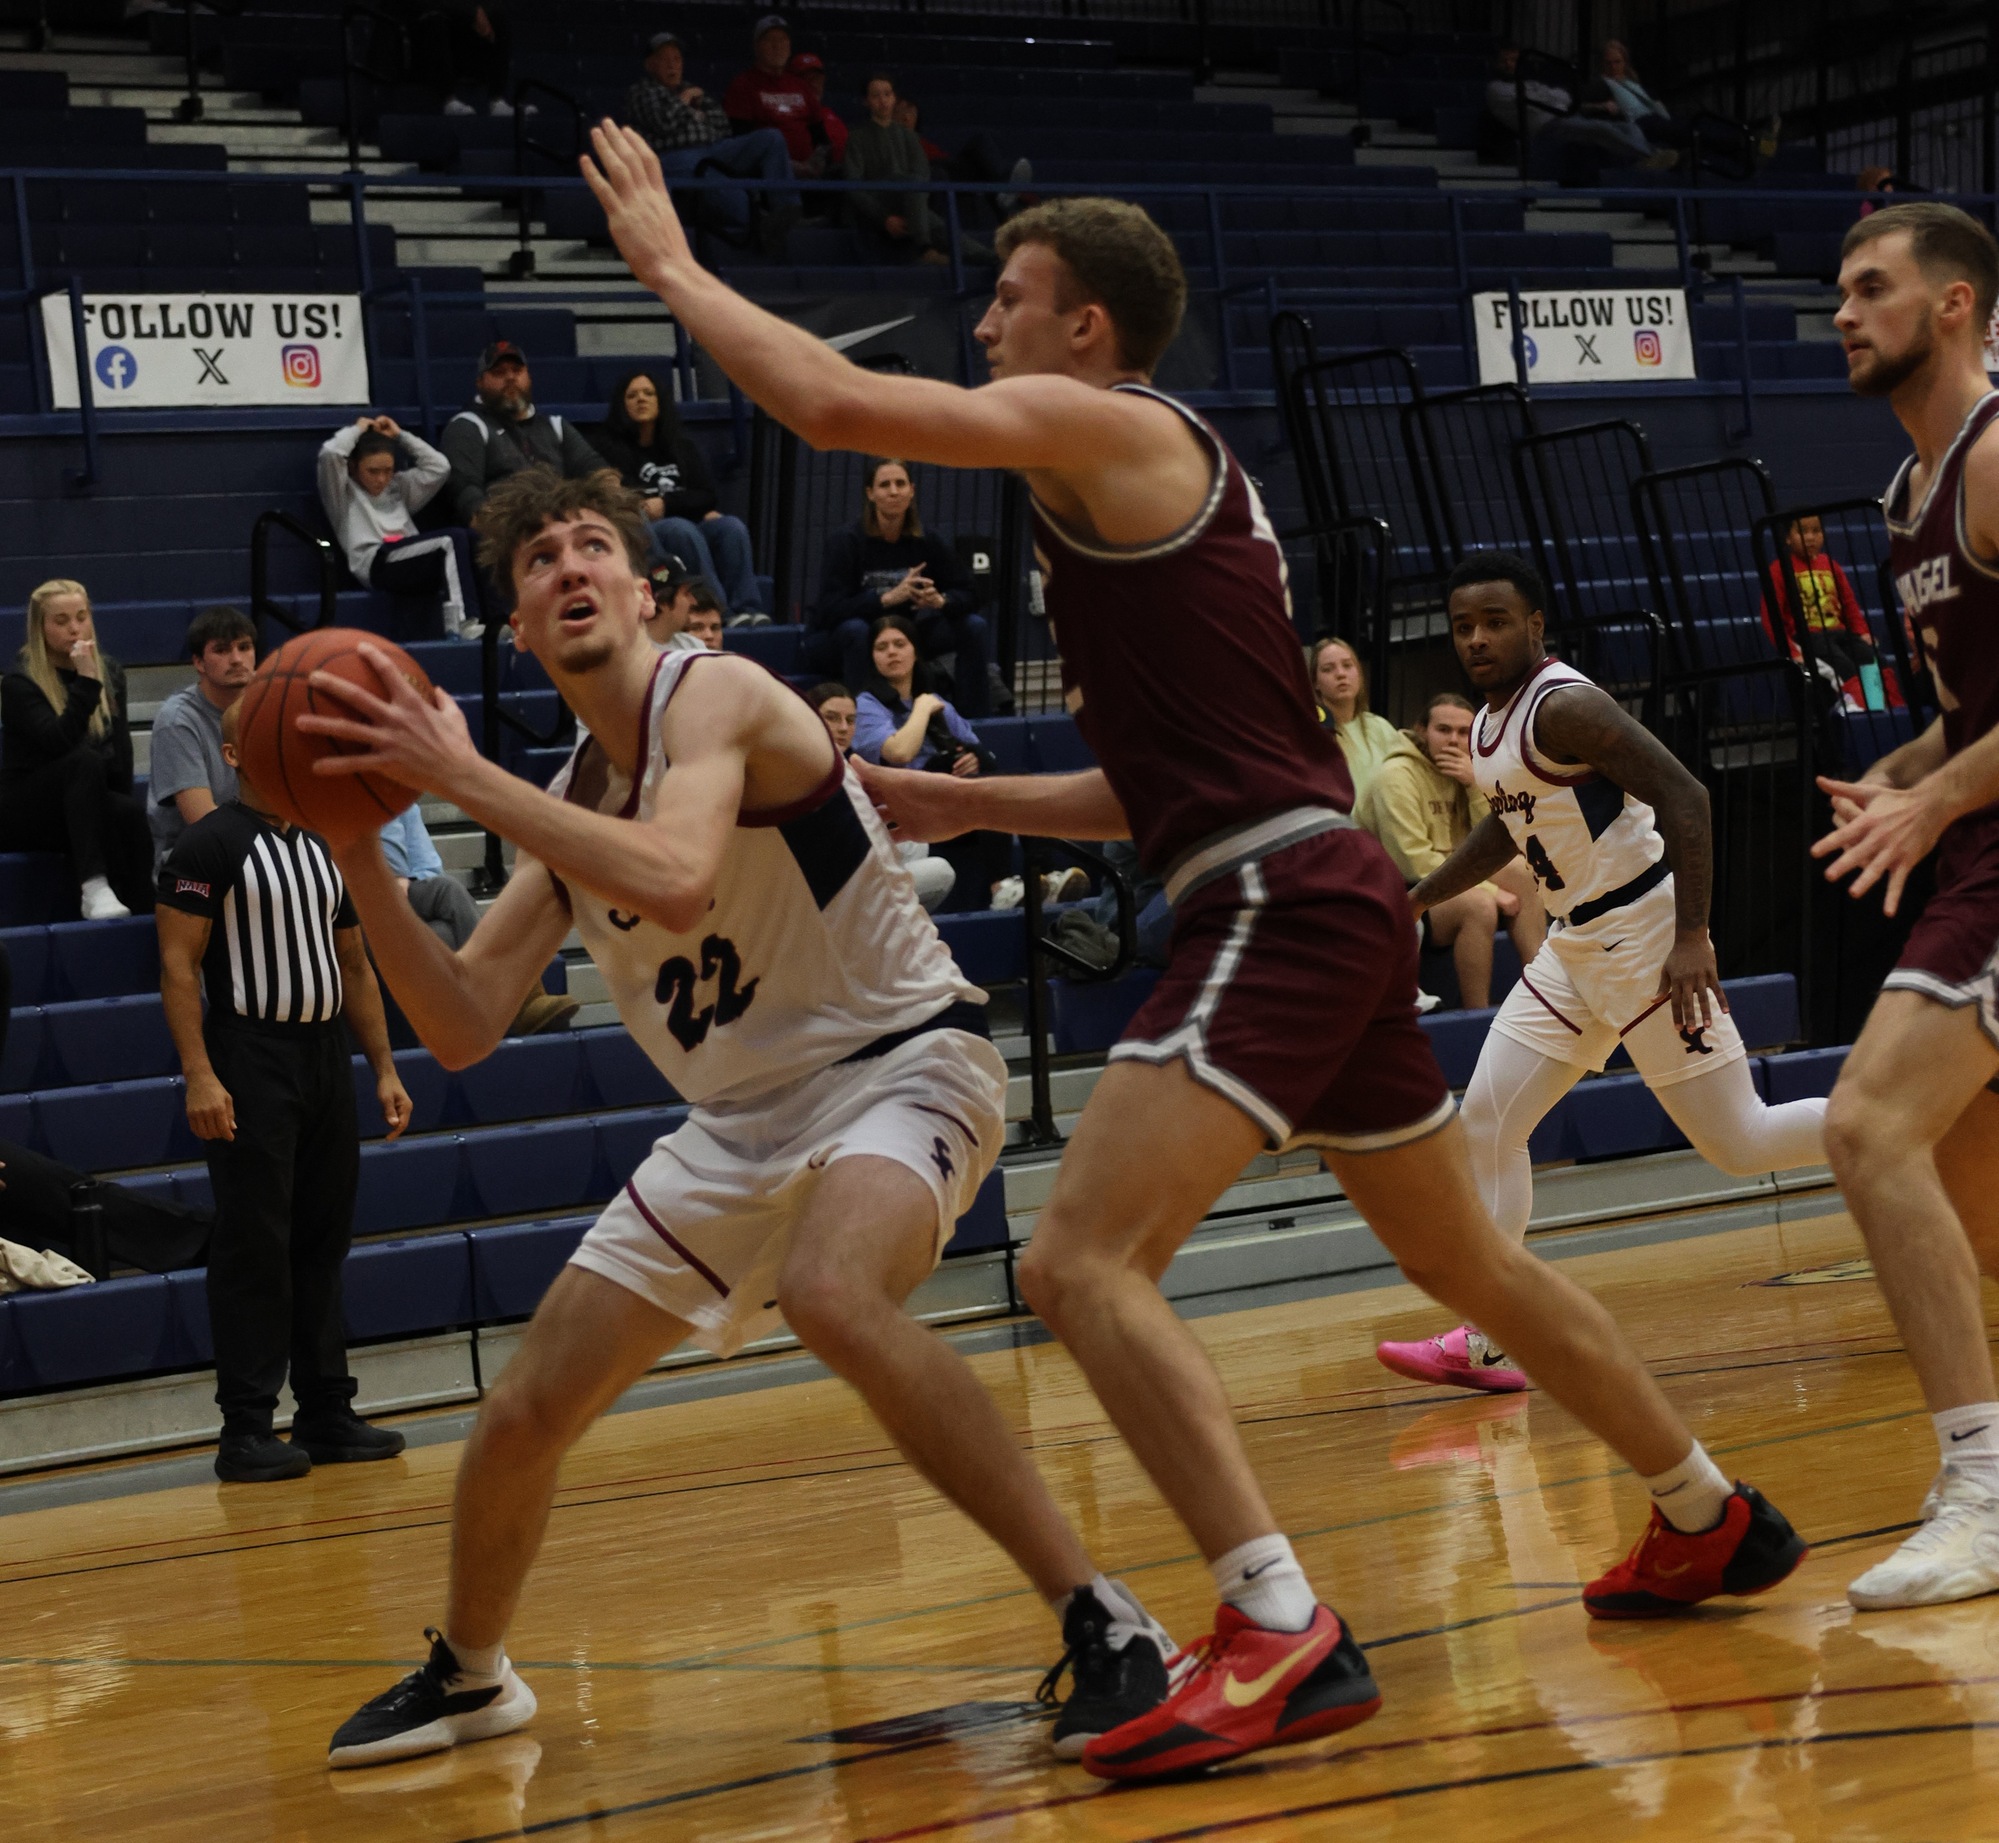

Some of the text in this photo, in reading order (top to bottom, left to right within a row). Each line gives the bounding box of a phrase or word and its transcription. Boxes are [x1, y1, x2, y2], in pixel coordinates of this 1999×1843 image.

[272, 303, 342, 338] US!
[1625, 297, 1673, 325] US!
[177, 880, 209, 897] NAIA
[655, 933, 760, 1053] 22
